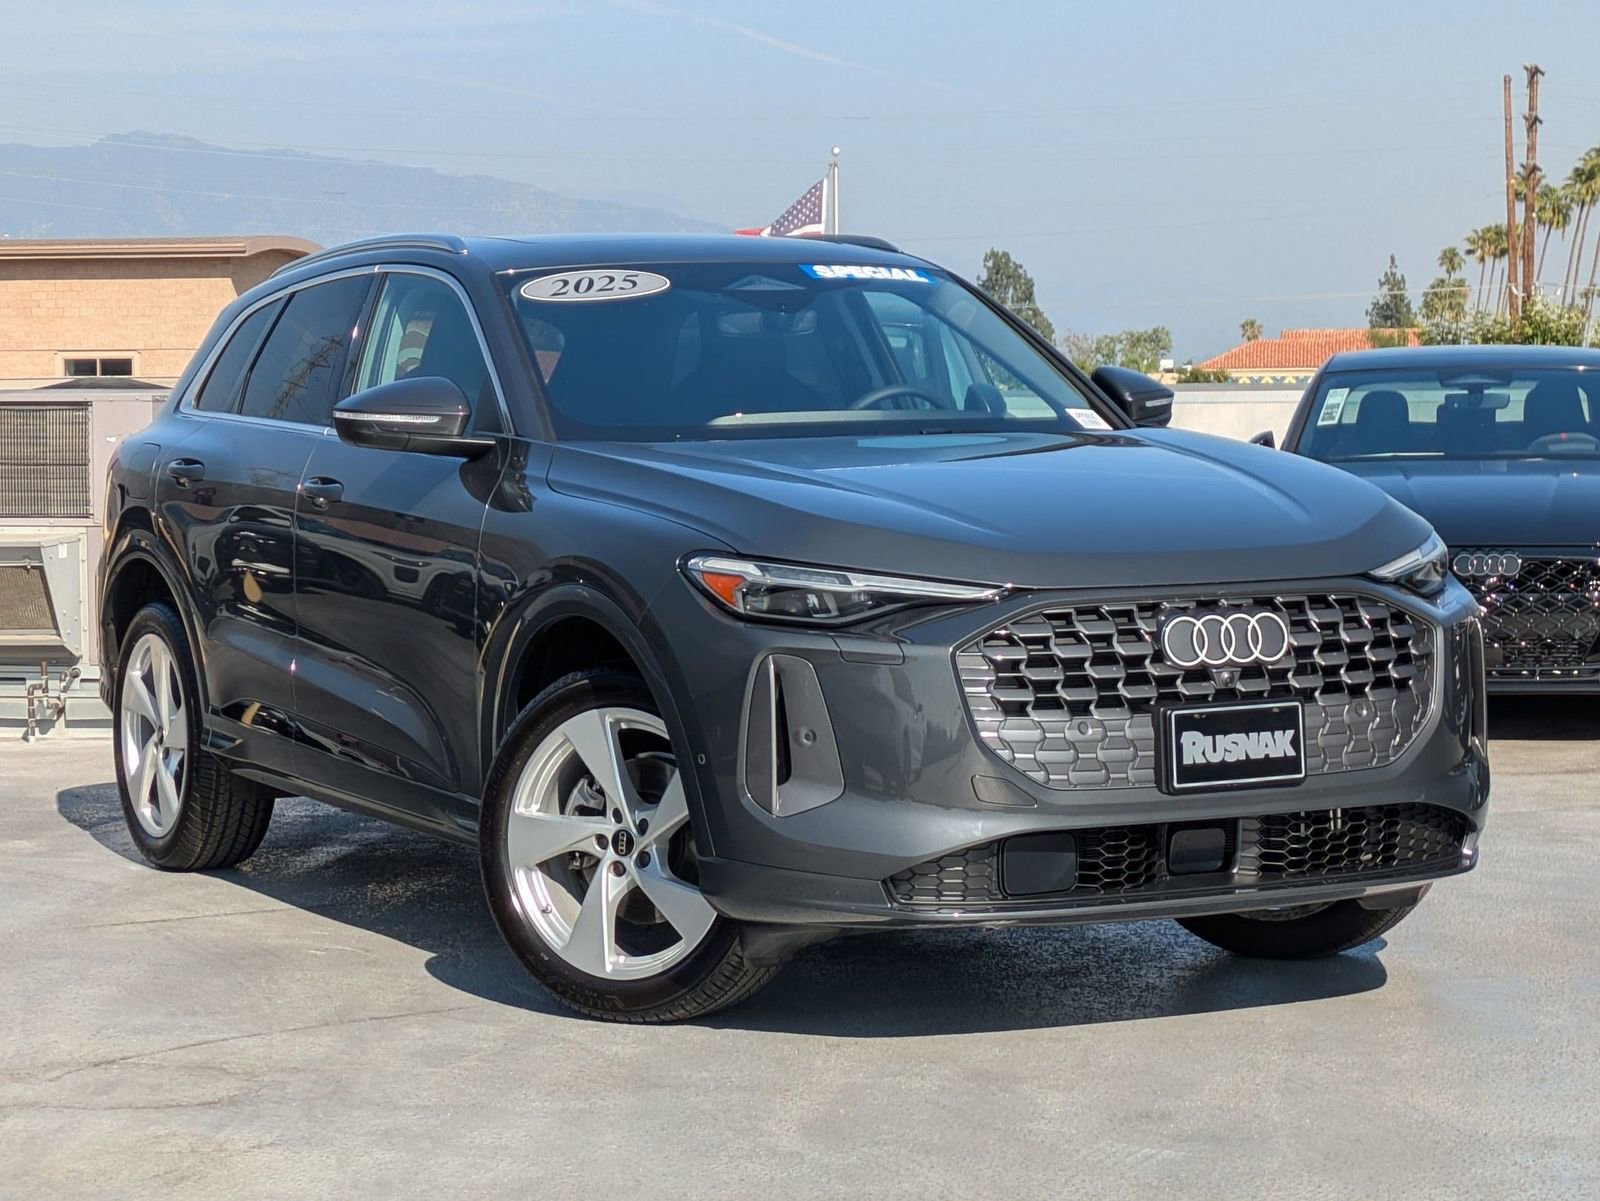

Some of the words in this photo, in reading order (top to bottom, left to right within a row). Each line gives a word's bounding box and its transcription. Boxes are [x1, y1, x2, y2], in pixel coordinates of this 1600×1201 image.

[812, 265, 929, 282] SPECIAL
[550, 274, 639, 297] 2025
[1180, 729, 1296, 765] RUSNAK
